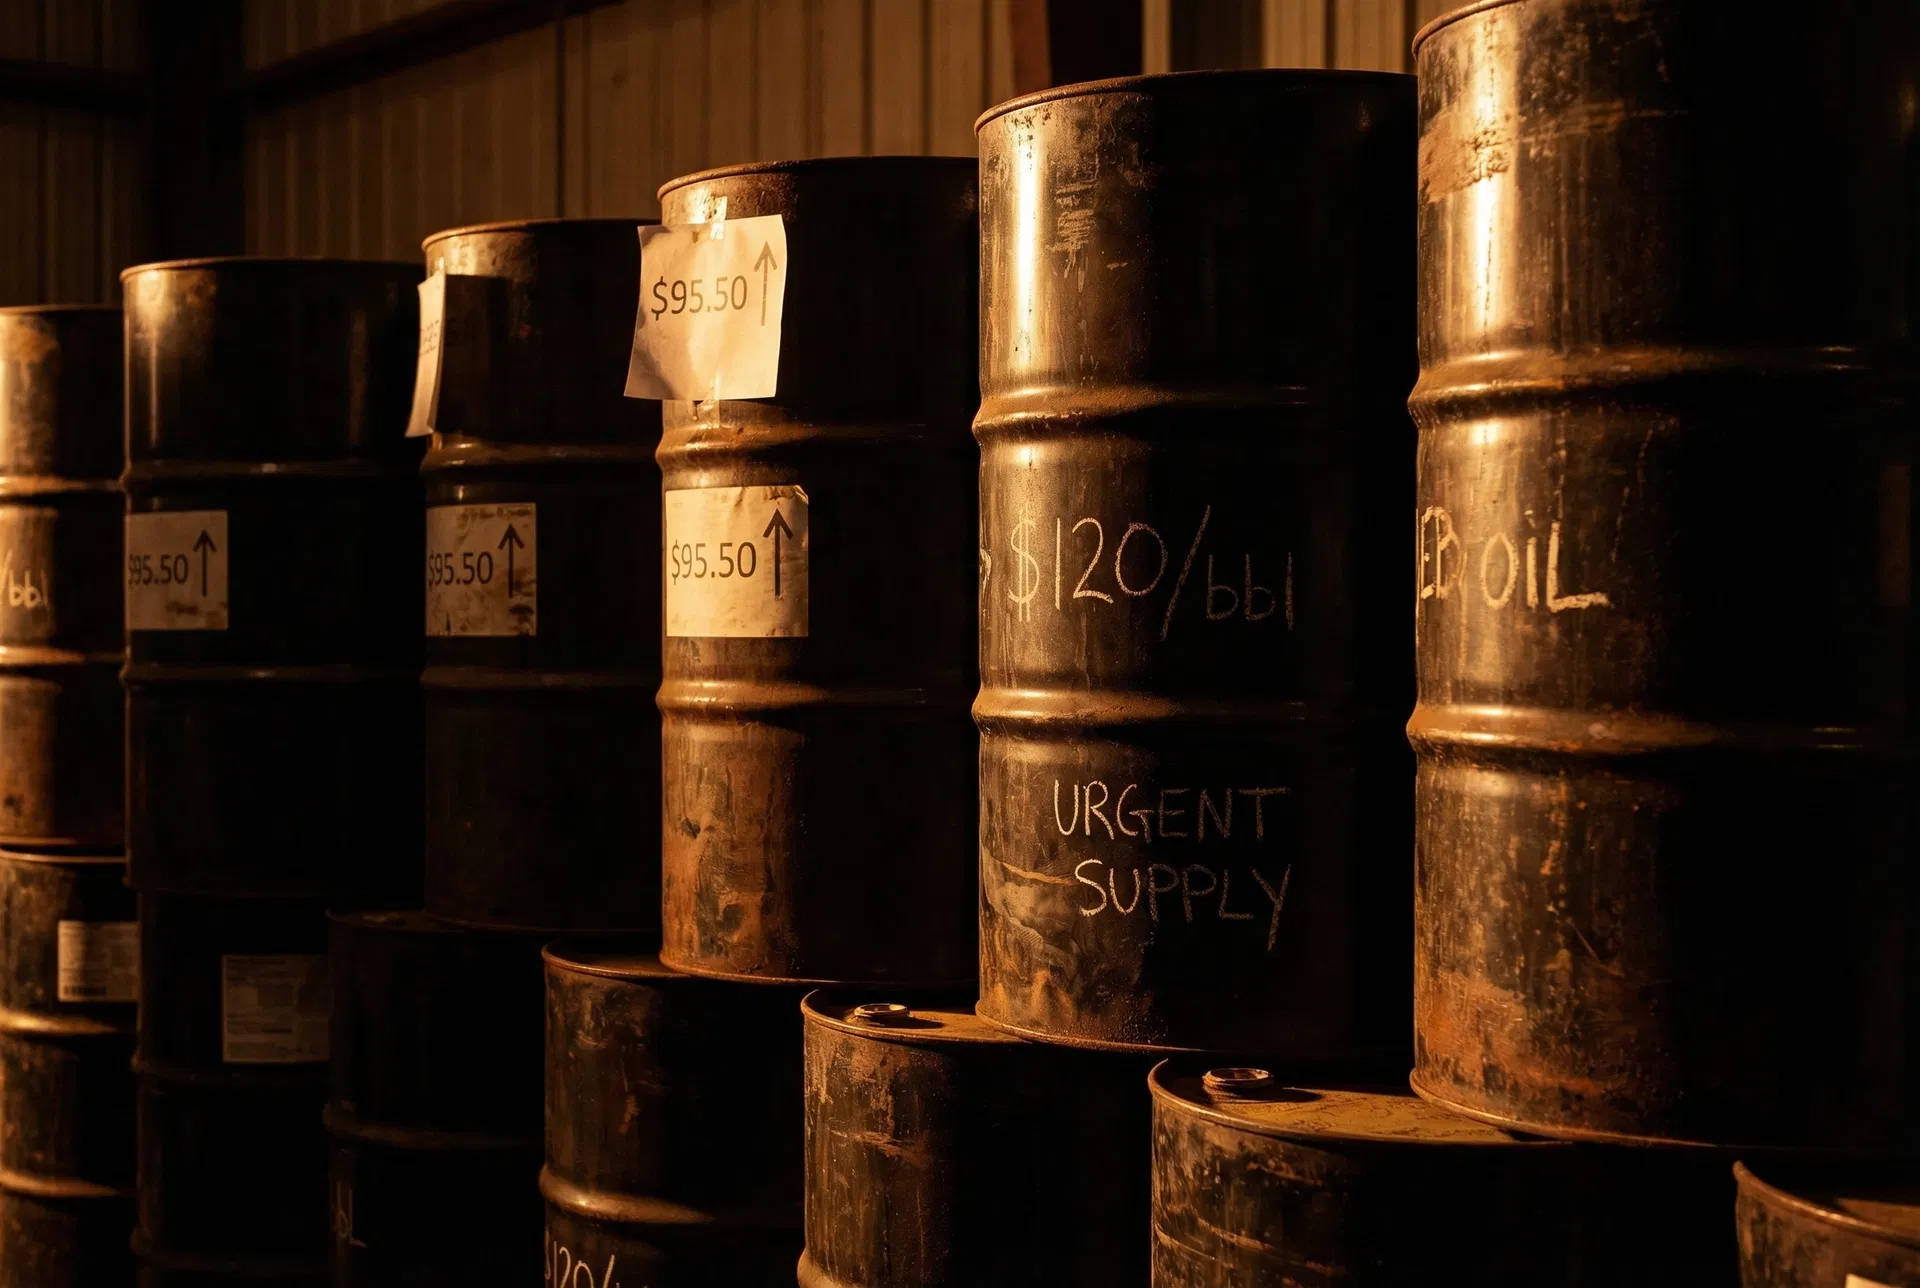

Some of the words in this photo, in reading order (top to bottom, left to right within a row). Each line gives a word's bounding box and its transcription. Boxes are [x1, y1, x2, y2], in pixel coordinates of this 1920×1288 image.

[650, 275, 748, 321] $95.50
[428, 550, 494, 591] $95.50
[671, 539, 757, 585] $95.50
[1008, 504, 1294, 641] $120/bbl
[1053, 780, 1291, 843] URGENT
[1074, 859, 1291, 952] SUPPLY
